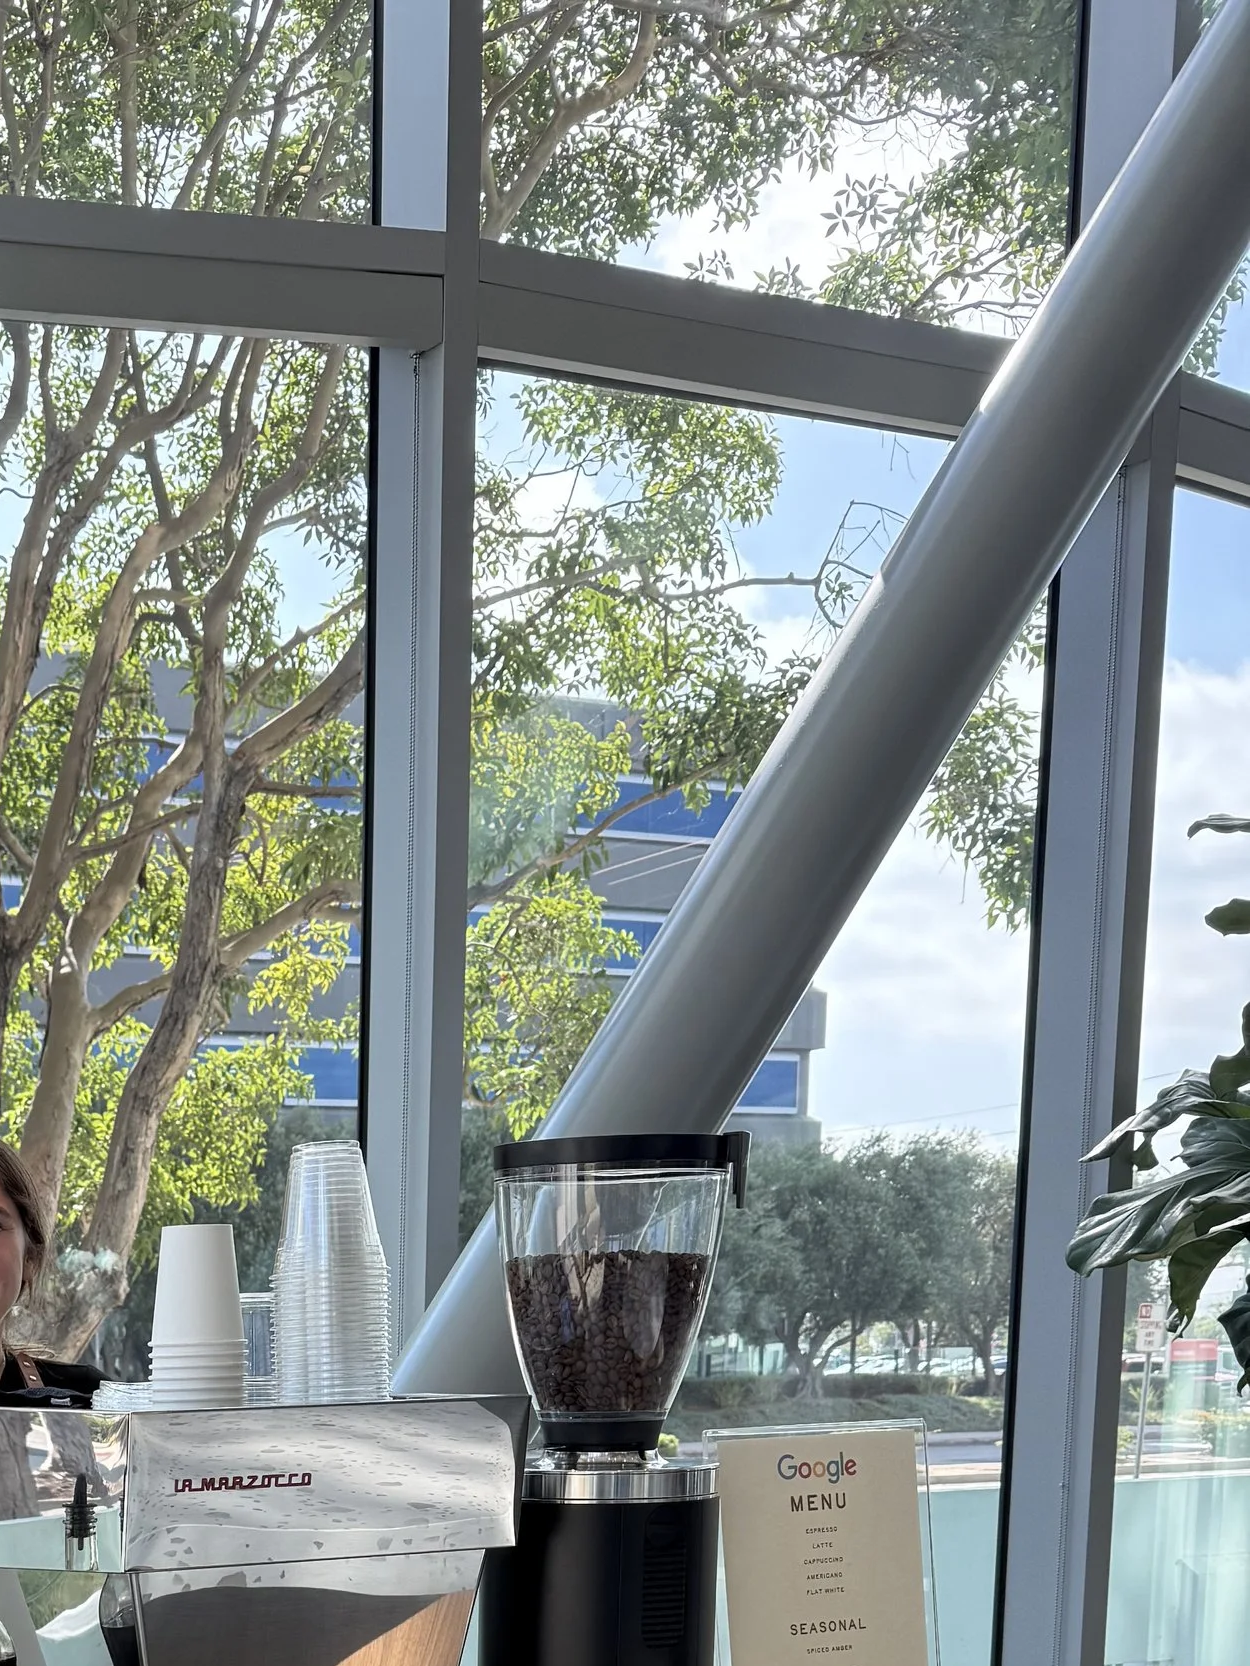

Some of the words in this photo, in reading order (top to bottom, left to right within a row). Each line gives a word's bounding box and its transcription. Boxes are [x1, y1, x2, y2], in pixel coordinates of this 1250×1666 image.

[777, 1451, 857, 1484] Google
[174, 1479, 193, 1492] LA
[201, 1472, 312, 1491] MARZOCCO
[790, 1492, 846, 1512] MENU
[805, 1526, 838, 1534] ESPRESSO
[803, 1556, 844, 1565] CAPPUCCINO
[807, 1572, 843, 1580] AMERICANO
[807, 1588, 823, 1596] FLAT
[825, 1586, 845, 1594] WHITE
[790, 1617, 867, 1636] SEASONAL
[806, 1646, 830, 1655] SPICED
[832, 1644, 853, 1652] AMBER
